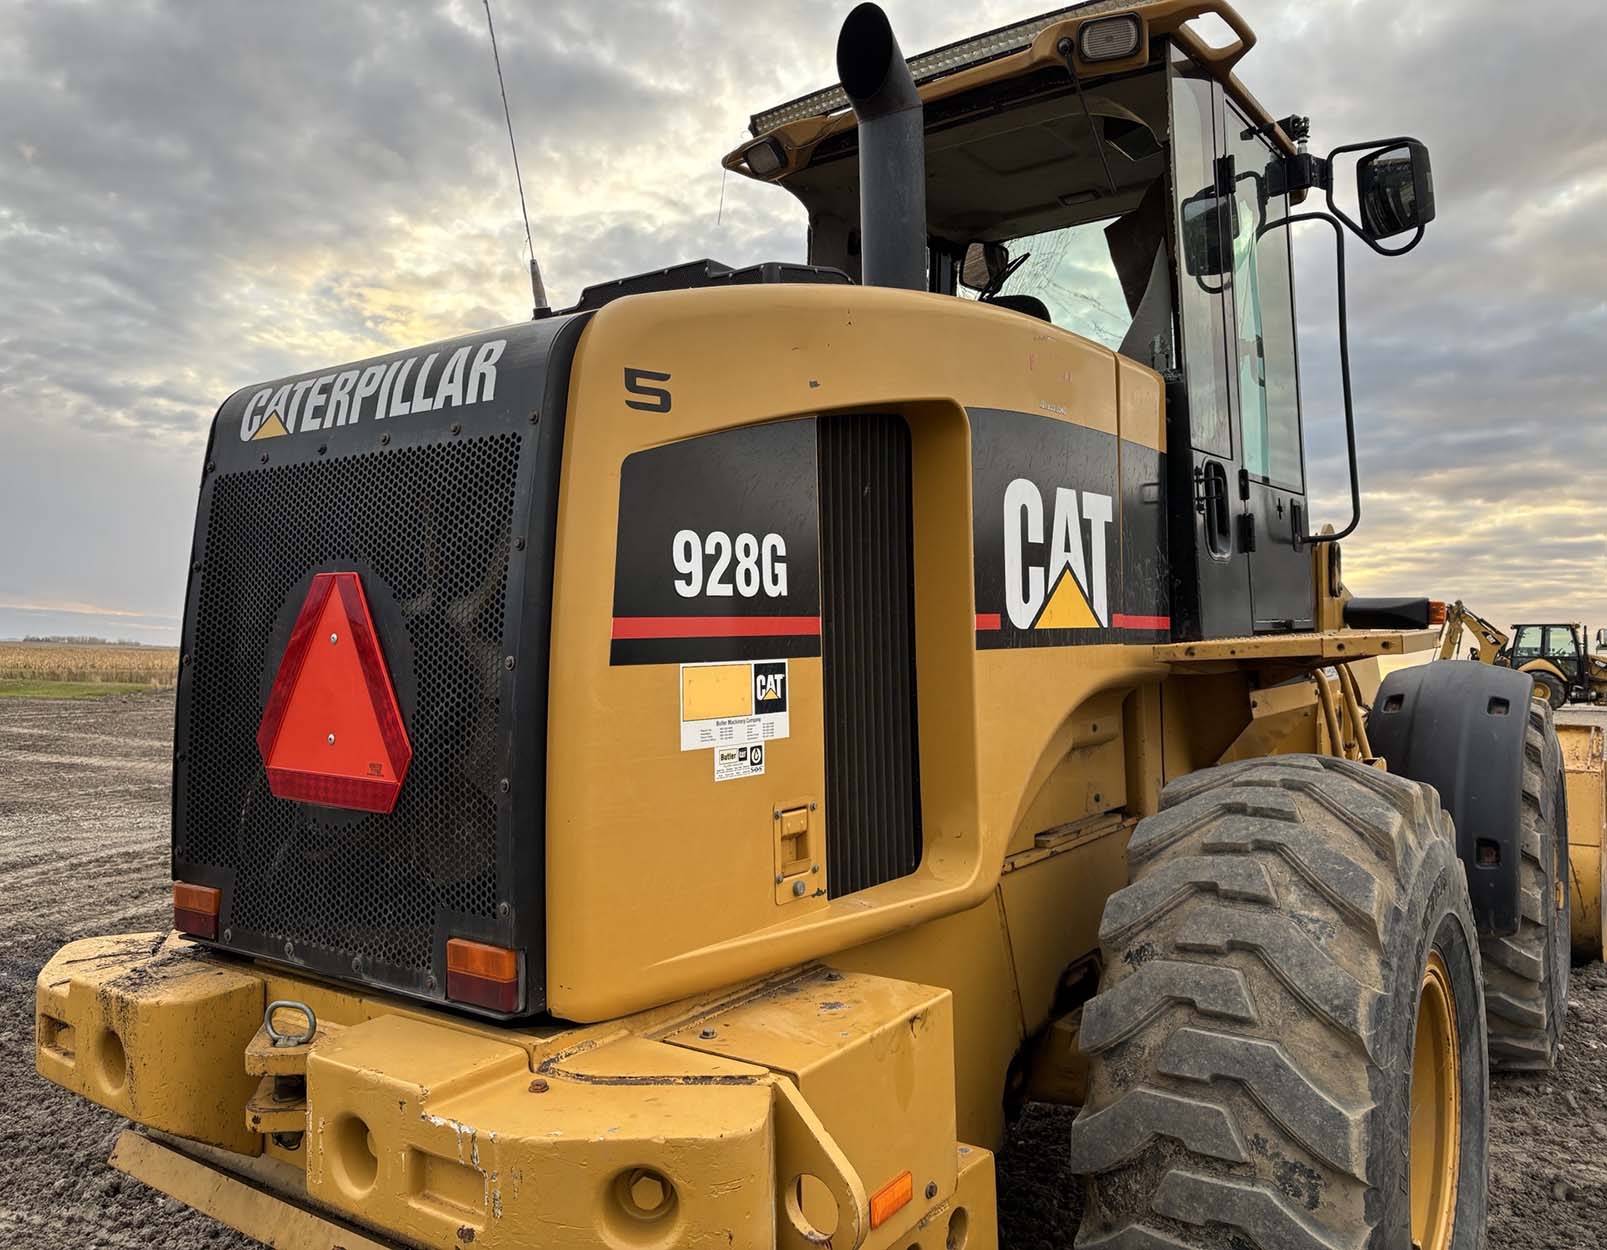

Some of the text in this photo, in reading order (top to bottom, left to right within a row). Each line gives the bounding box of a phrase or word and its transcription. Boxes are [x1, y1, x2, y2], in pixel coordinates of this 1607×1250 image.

[240, 339, 507, 442] CATERPILLAR
[672, 529, 789, 598] 928G
[1003, 478, 1113, 630] CAT
[756, 673, 785, 701] CAT
[720, 752, 736, 761] Butler
